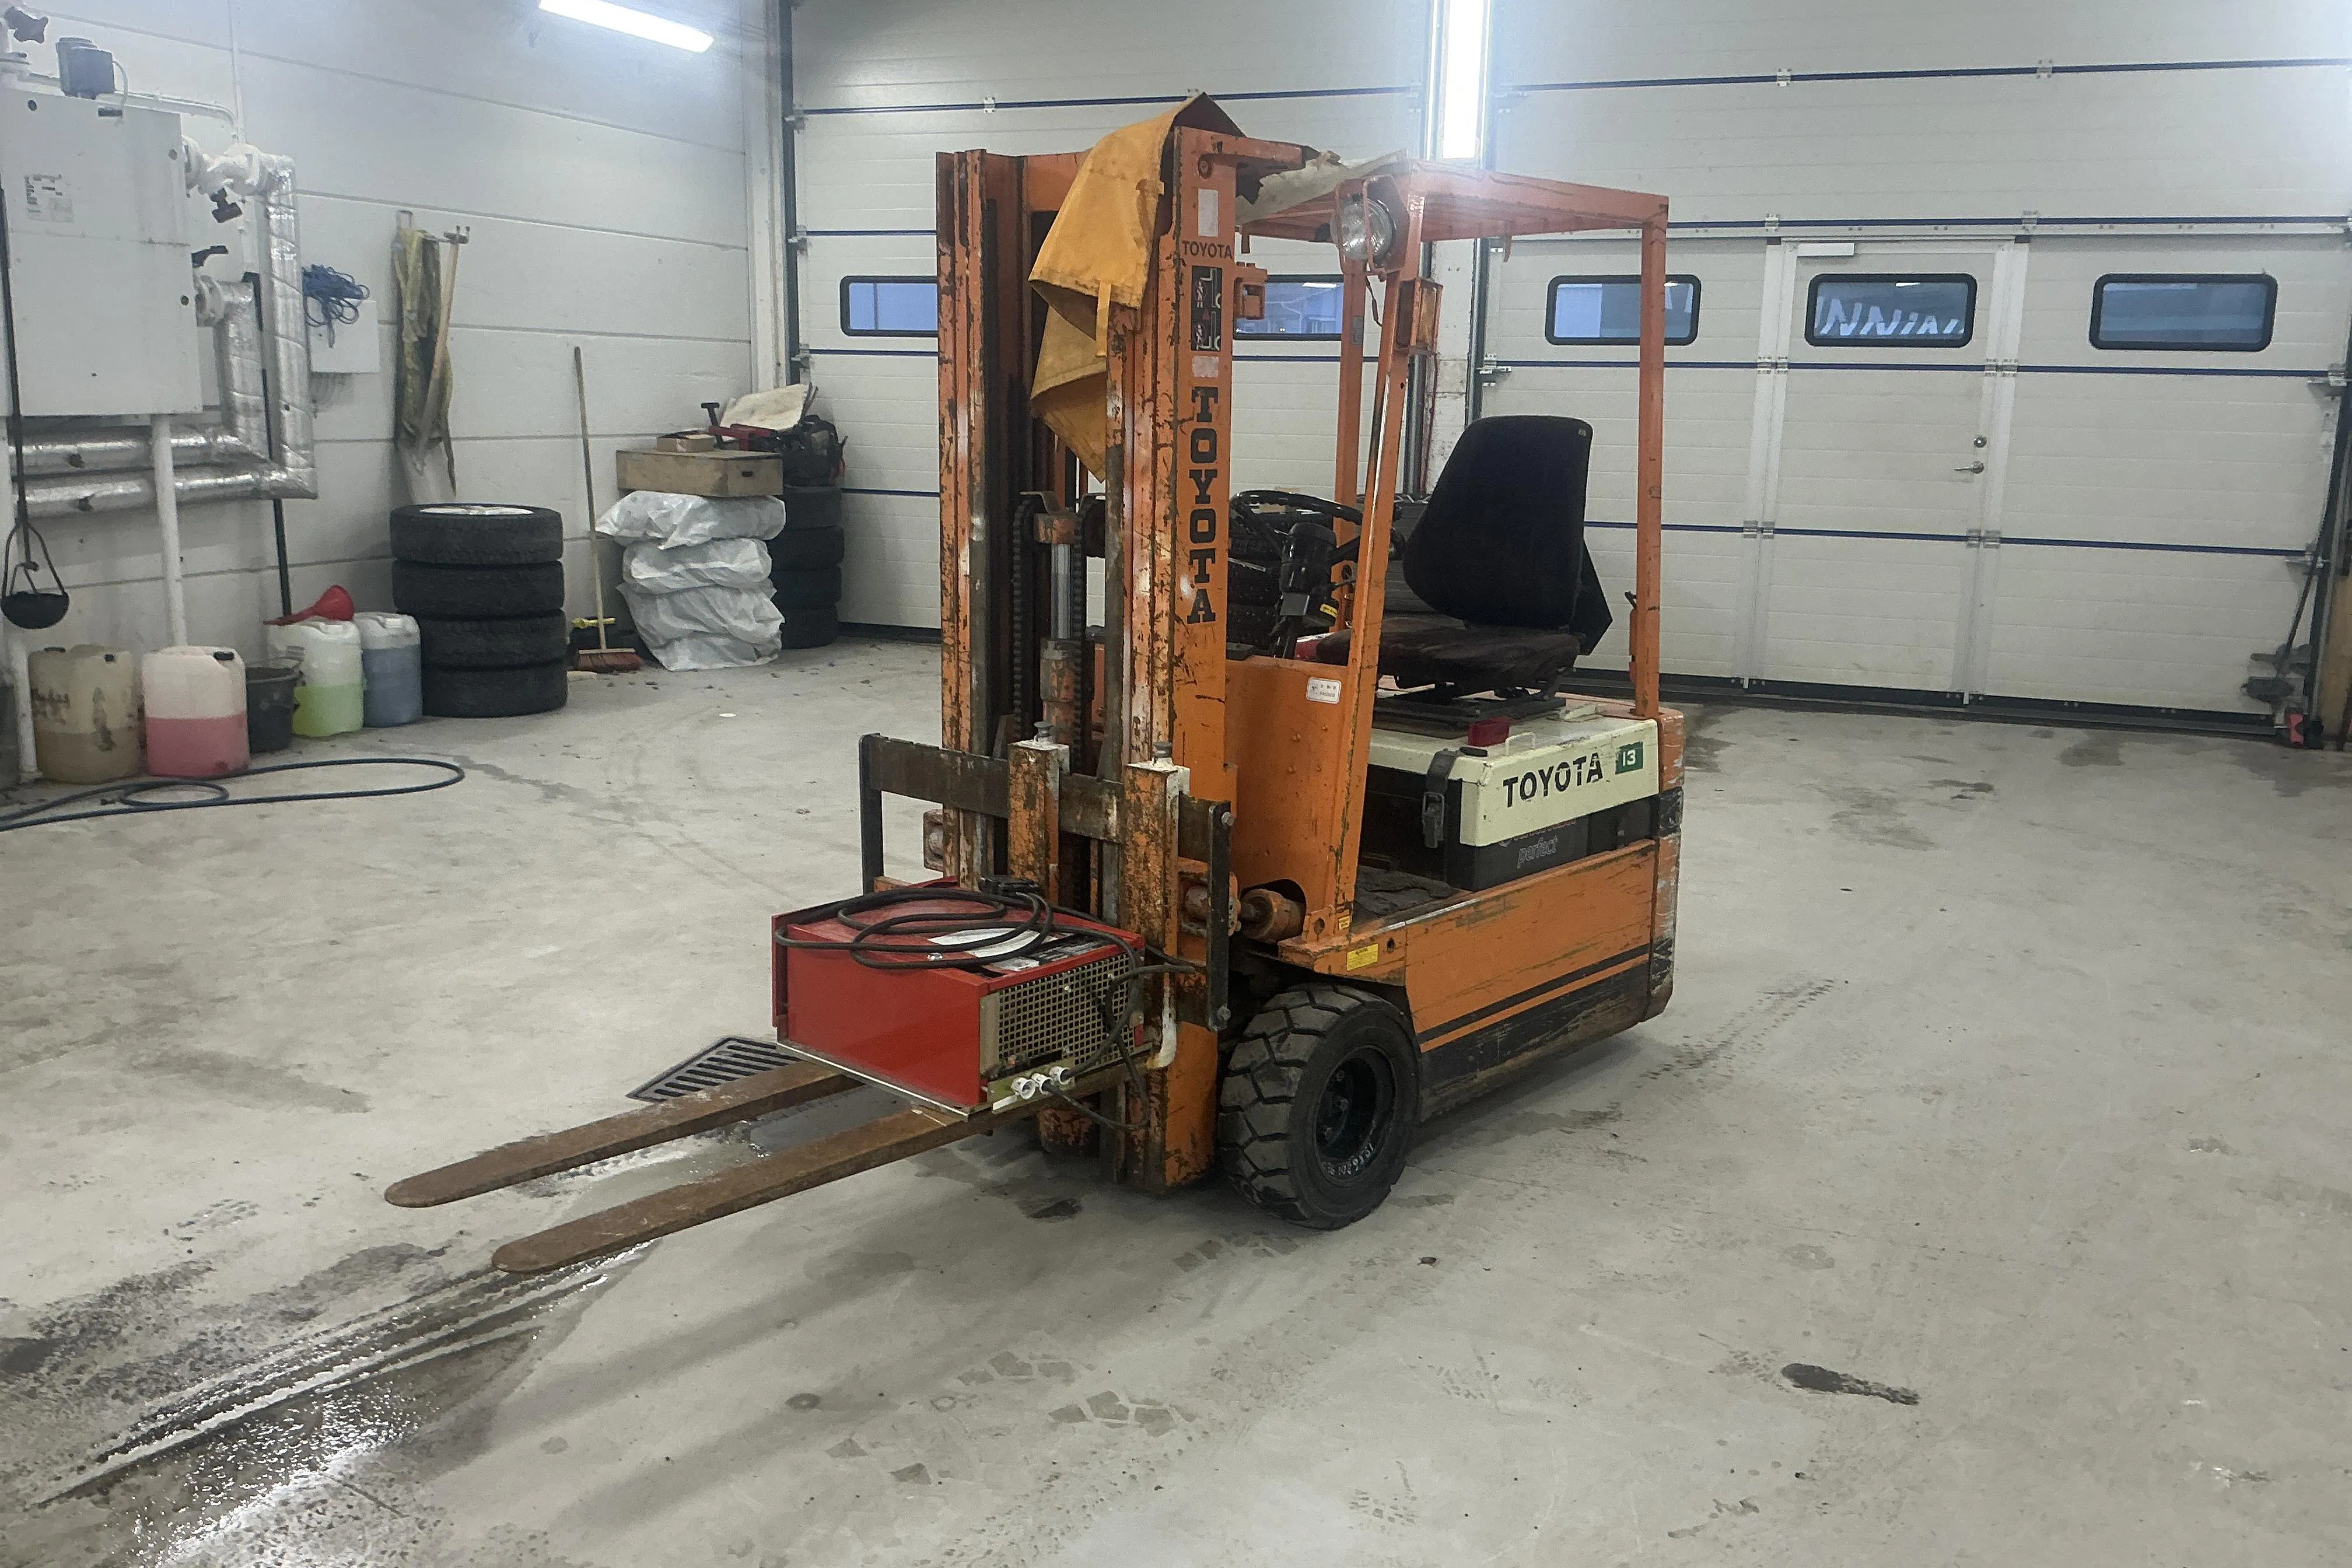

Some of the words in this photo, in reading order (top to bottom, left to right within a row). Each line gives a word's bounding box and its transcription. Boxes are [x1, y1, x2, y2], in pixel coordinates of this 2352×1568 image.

[1182, 240, 1233, 260] TOYOTA
[1186, 386, 1219, 625] TOYOTA
[1503, 752, 1604, 808] TOYOTA
[1622, 749, 1636, 767] 13
[1517, 835, 1559, 869] perfect
